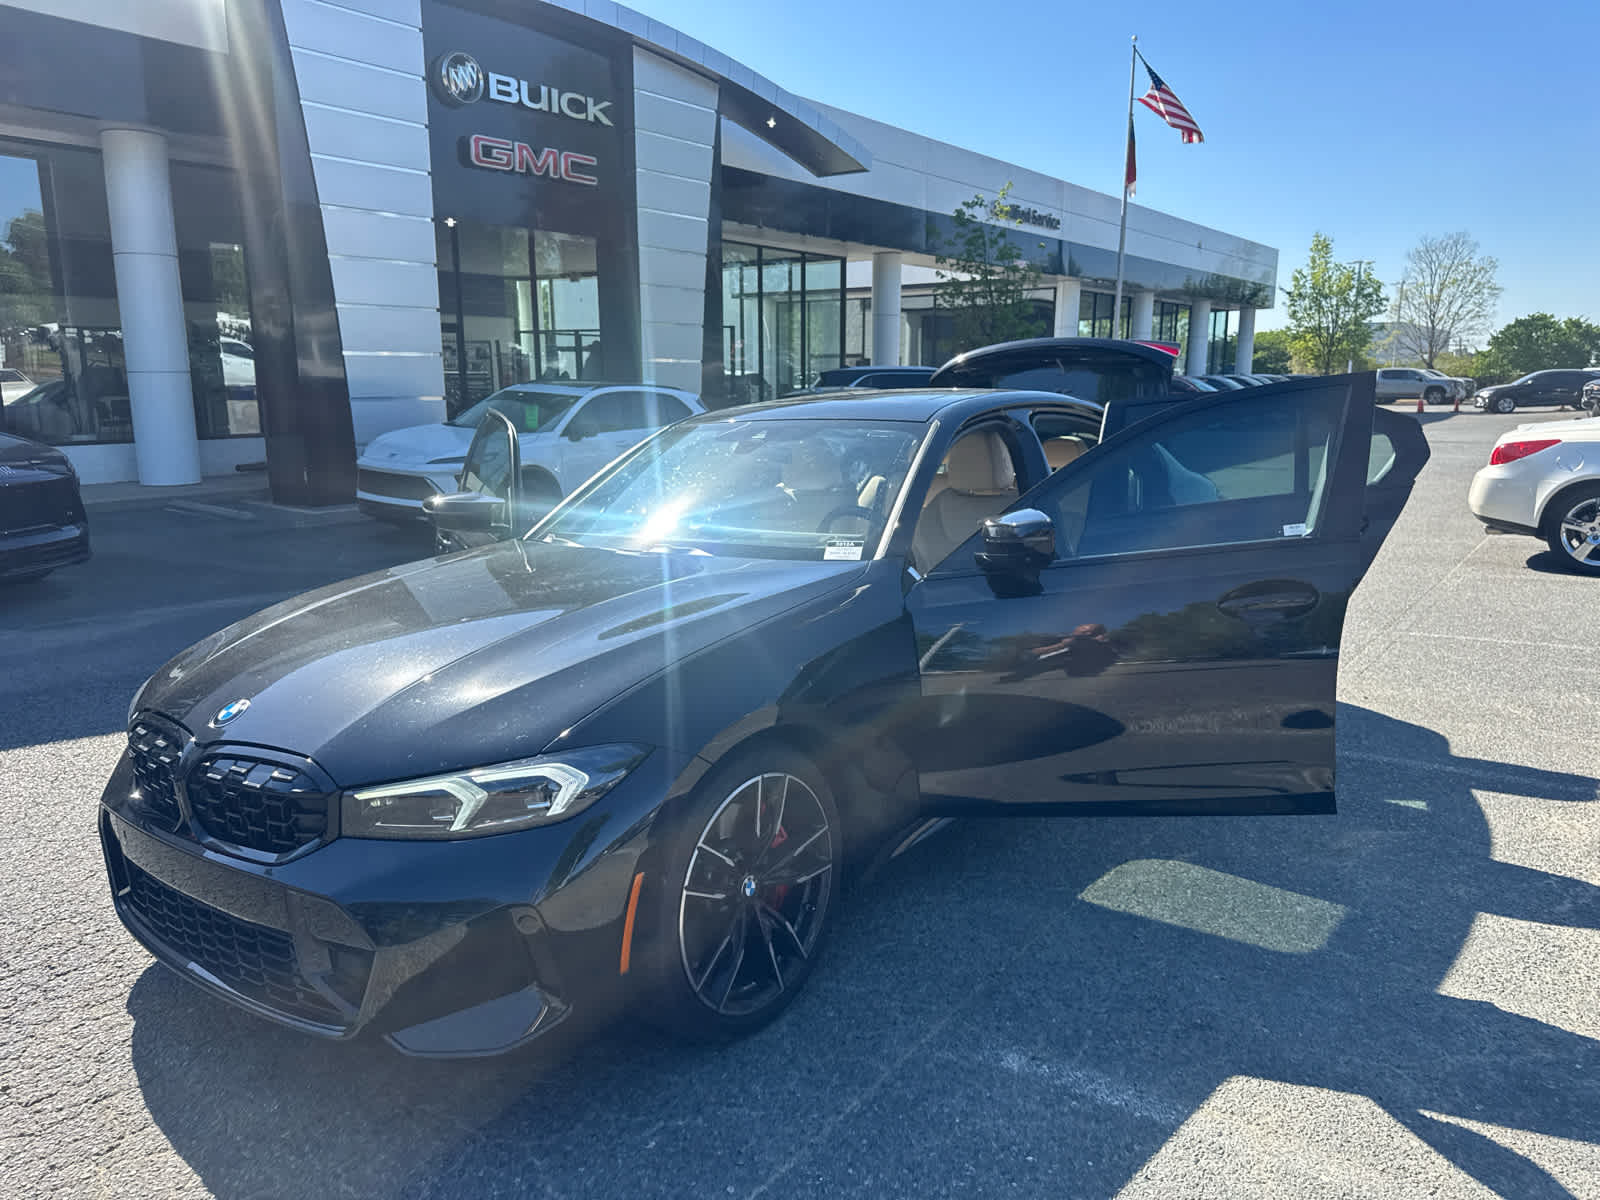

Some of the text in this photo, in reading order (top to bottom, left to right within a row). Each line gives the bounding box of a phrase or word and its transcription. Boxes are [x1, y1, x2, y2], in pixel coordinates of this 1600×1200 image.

[488, 71, 614, 127] BUICK
[470, 134, 598, 185] GMC
[1032, 208, 1061, 230] Service
